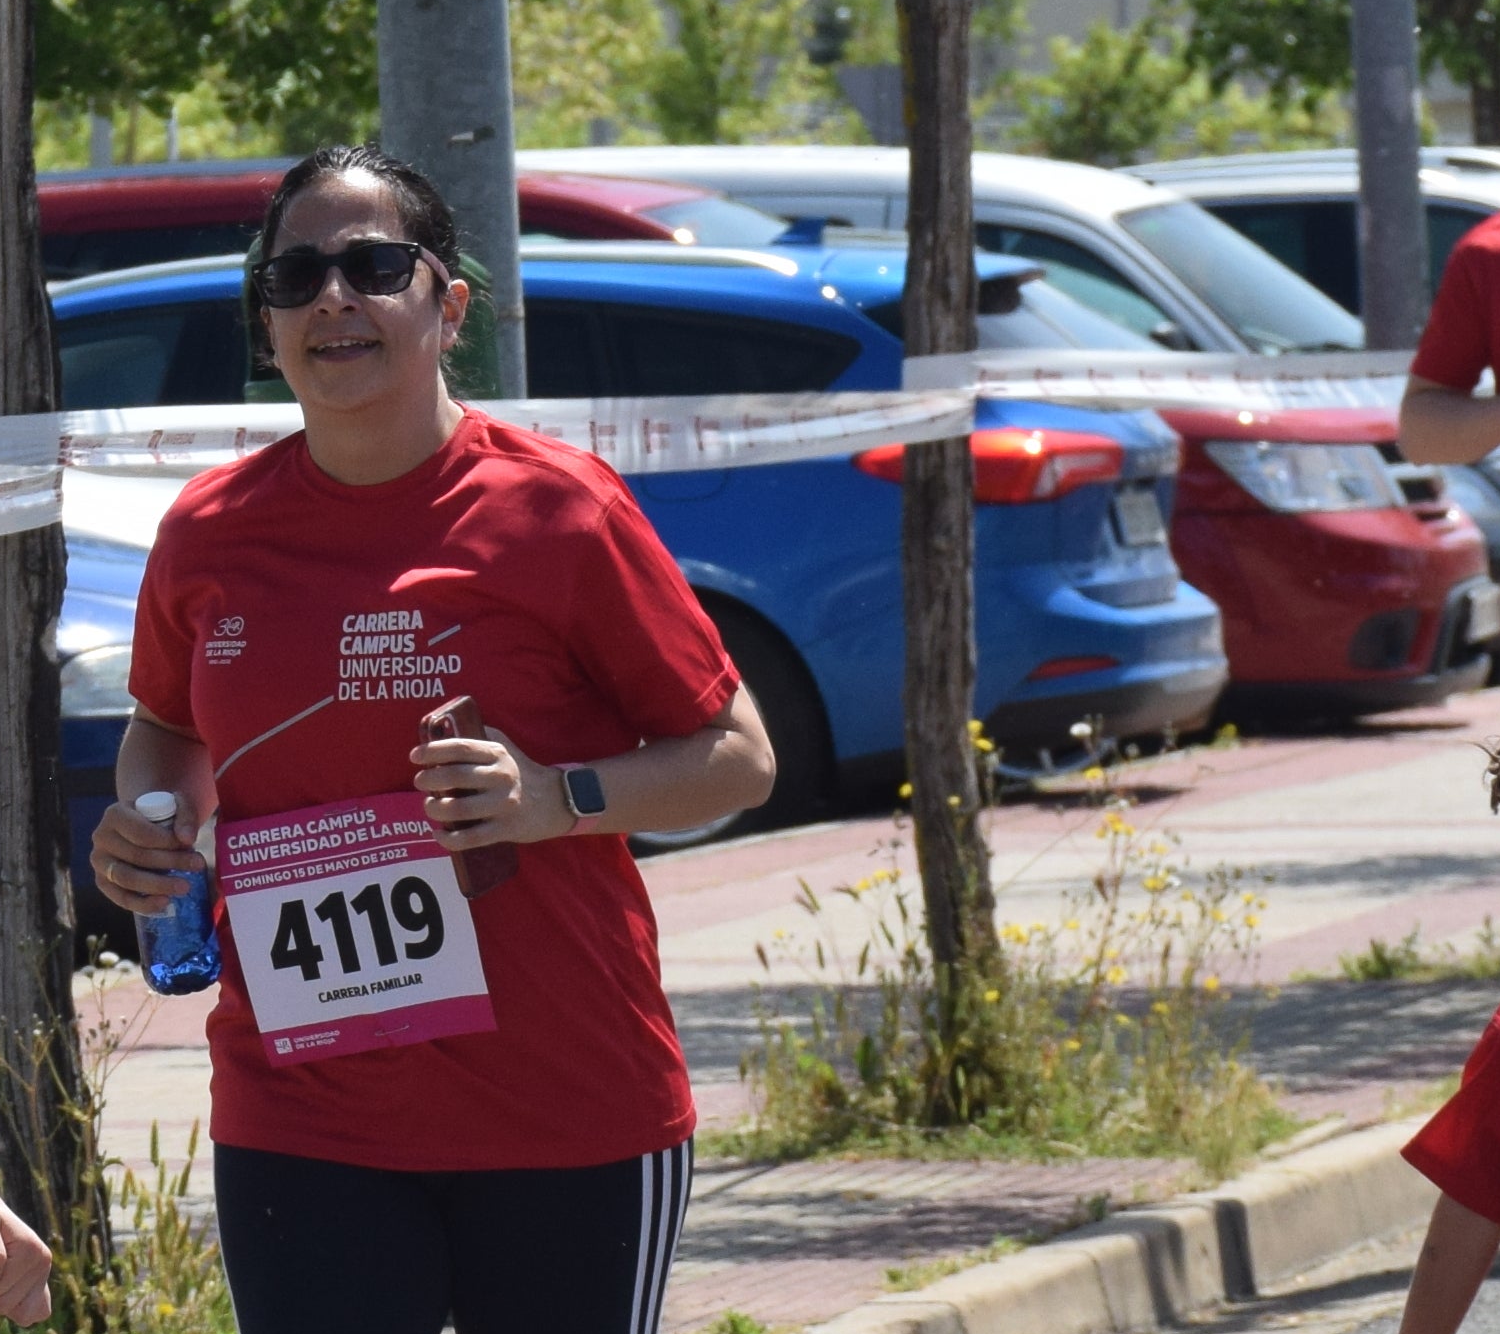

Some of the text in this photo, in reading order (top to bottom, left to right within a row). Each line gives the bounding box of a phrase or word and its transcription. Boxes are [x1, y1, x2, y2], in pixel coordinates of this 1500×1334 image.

[343, 610, 423, 633] CARRERA
[340, 634, 415, 655] CAMPUS
[340, 655, 461, 678] UNIVERSIDAD
[338, 678, 445, 701] DE LA RIOJA
[227, 809, 376, 849] CARRERA CAMPUS
[230, 821, 432, 866] UNIVERSIDAD DE LA RIOJA
[235, 848, 408, 889] DOMINGO 15 DE MAYO DE 2022
[270, 876, 444, 982] 4119
[318, 973, 423, 1003] CARRERA FAMILIAR
